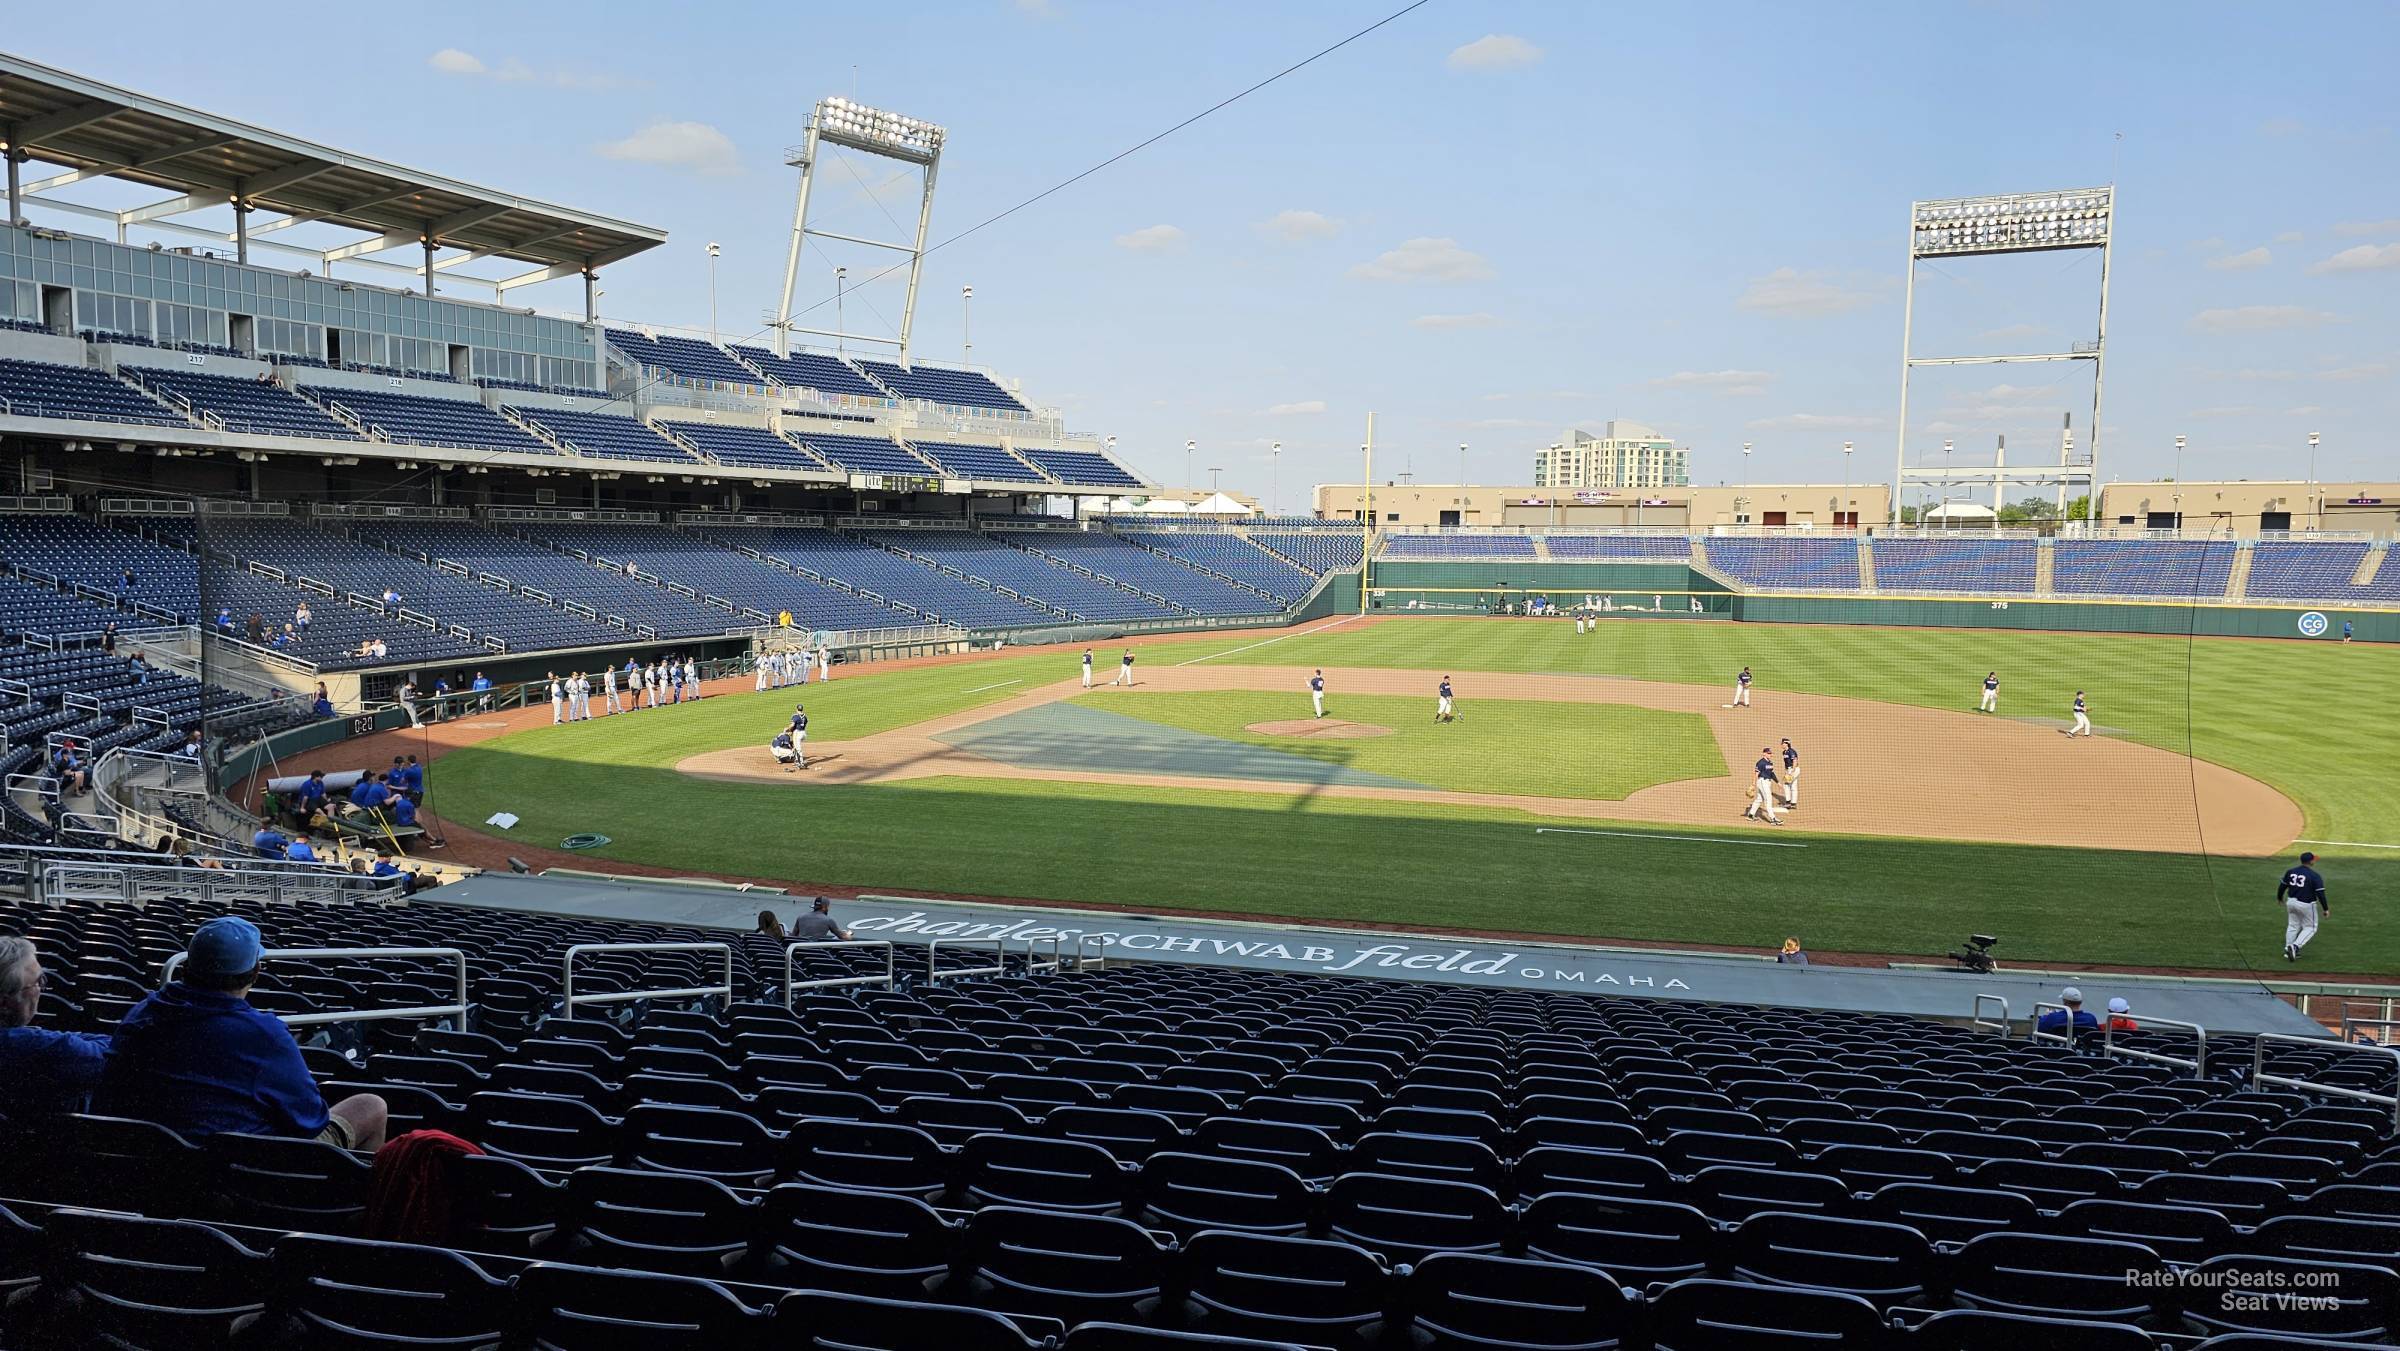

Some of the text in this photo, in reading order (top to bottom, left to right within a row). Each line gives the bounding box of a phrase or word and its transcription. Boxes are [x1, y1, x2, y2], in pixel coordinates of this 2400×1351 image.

[189, 355, 203, 363] 217
[390, 378, 402, 386] 218
[2303, 619, 2323, 629] CG
[355, 716, 373, 733] 0:20
[2289, 873, 2306, 888] 33
[847, 912, 1690, 990] charles SCHWAB field OMAHA
